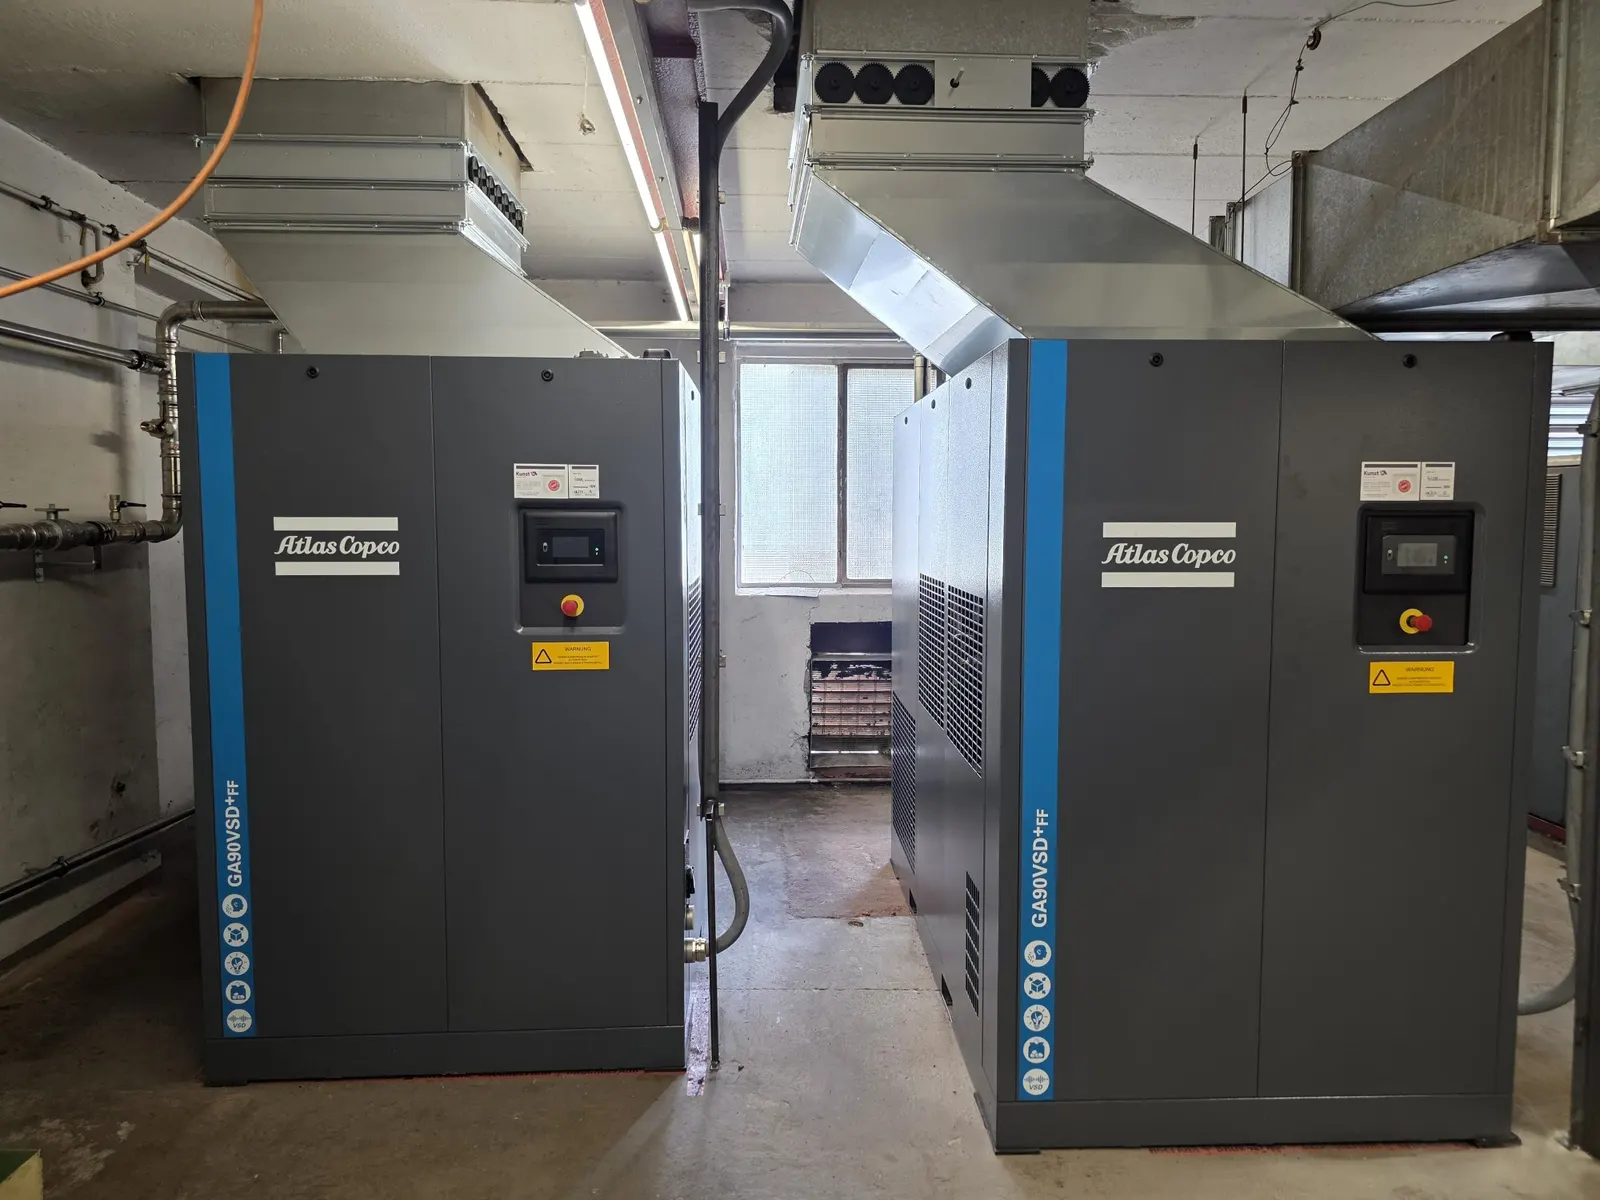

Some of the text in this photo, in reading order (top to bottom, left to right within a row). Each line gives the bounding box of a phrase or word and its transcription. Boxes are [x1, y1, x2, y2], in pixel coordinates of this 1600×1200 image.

[273, 535, 400, 559] Atlas Copco
[1101, 542, 1237, 569] Atlas Copco
